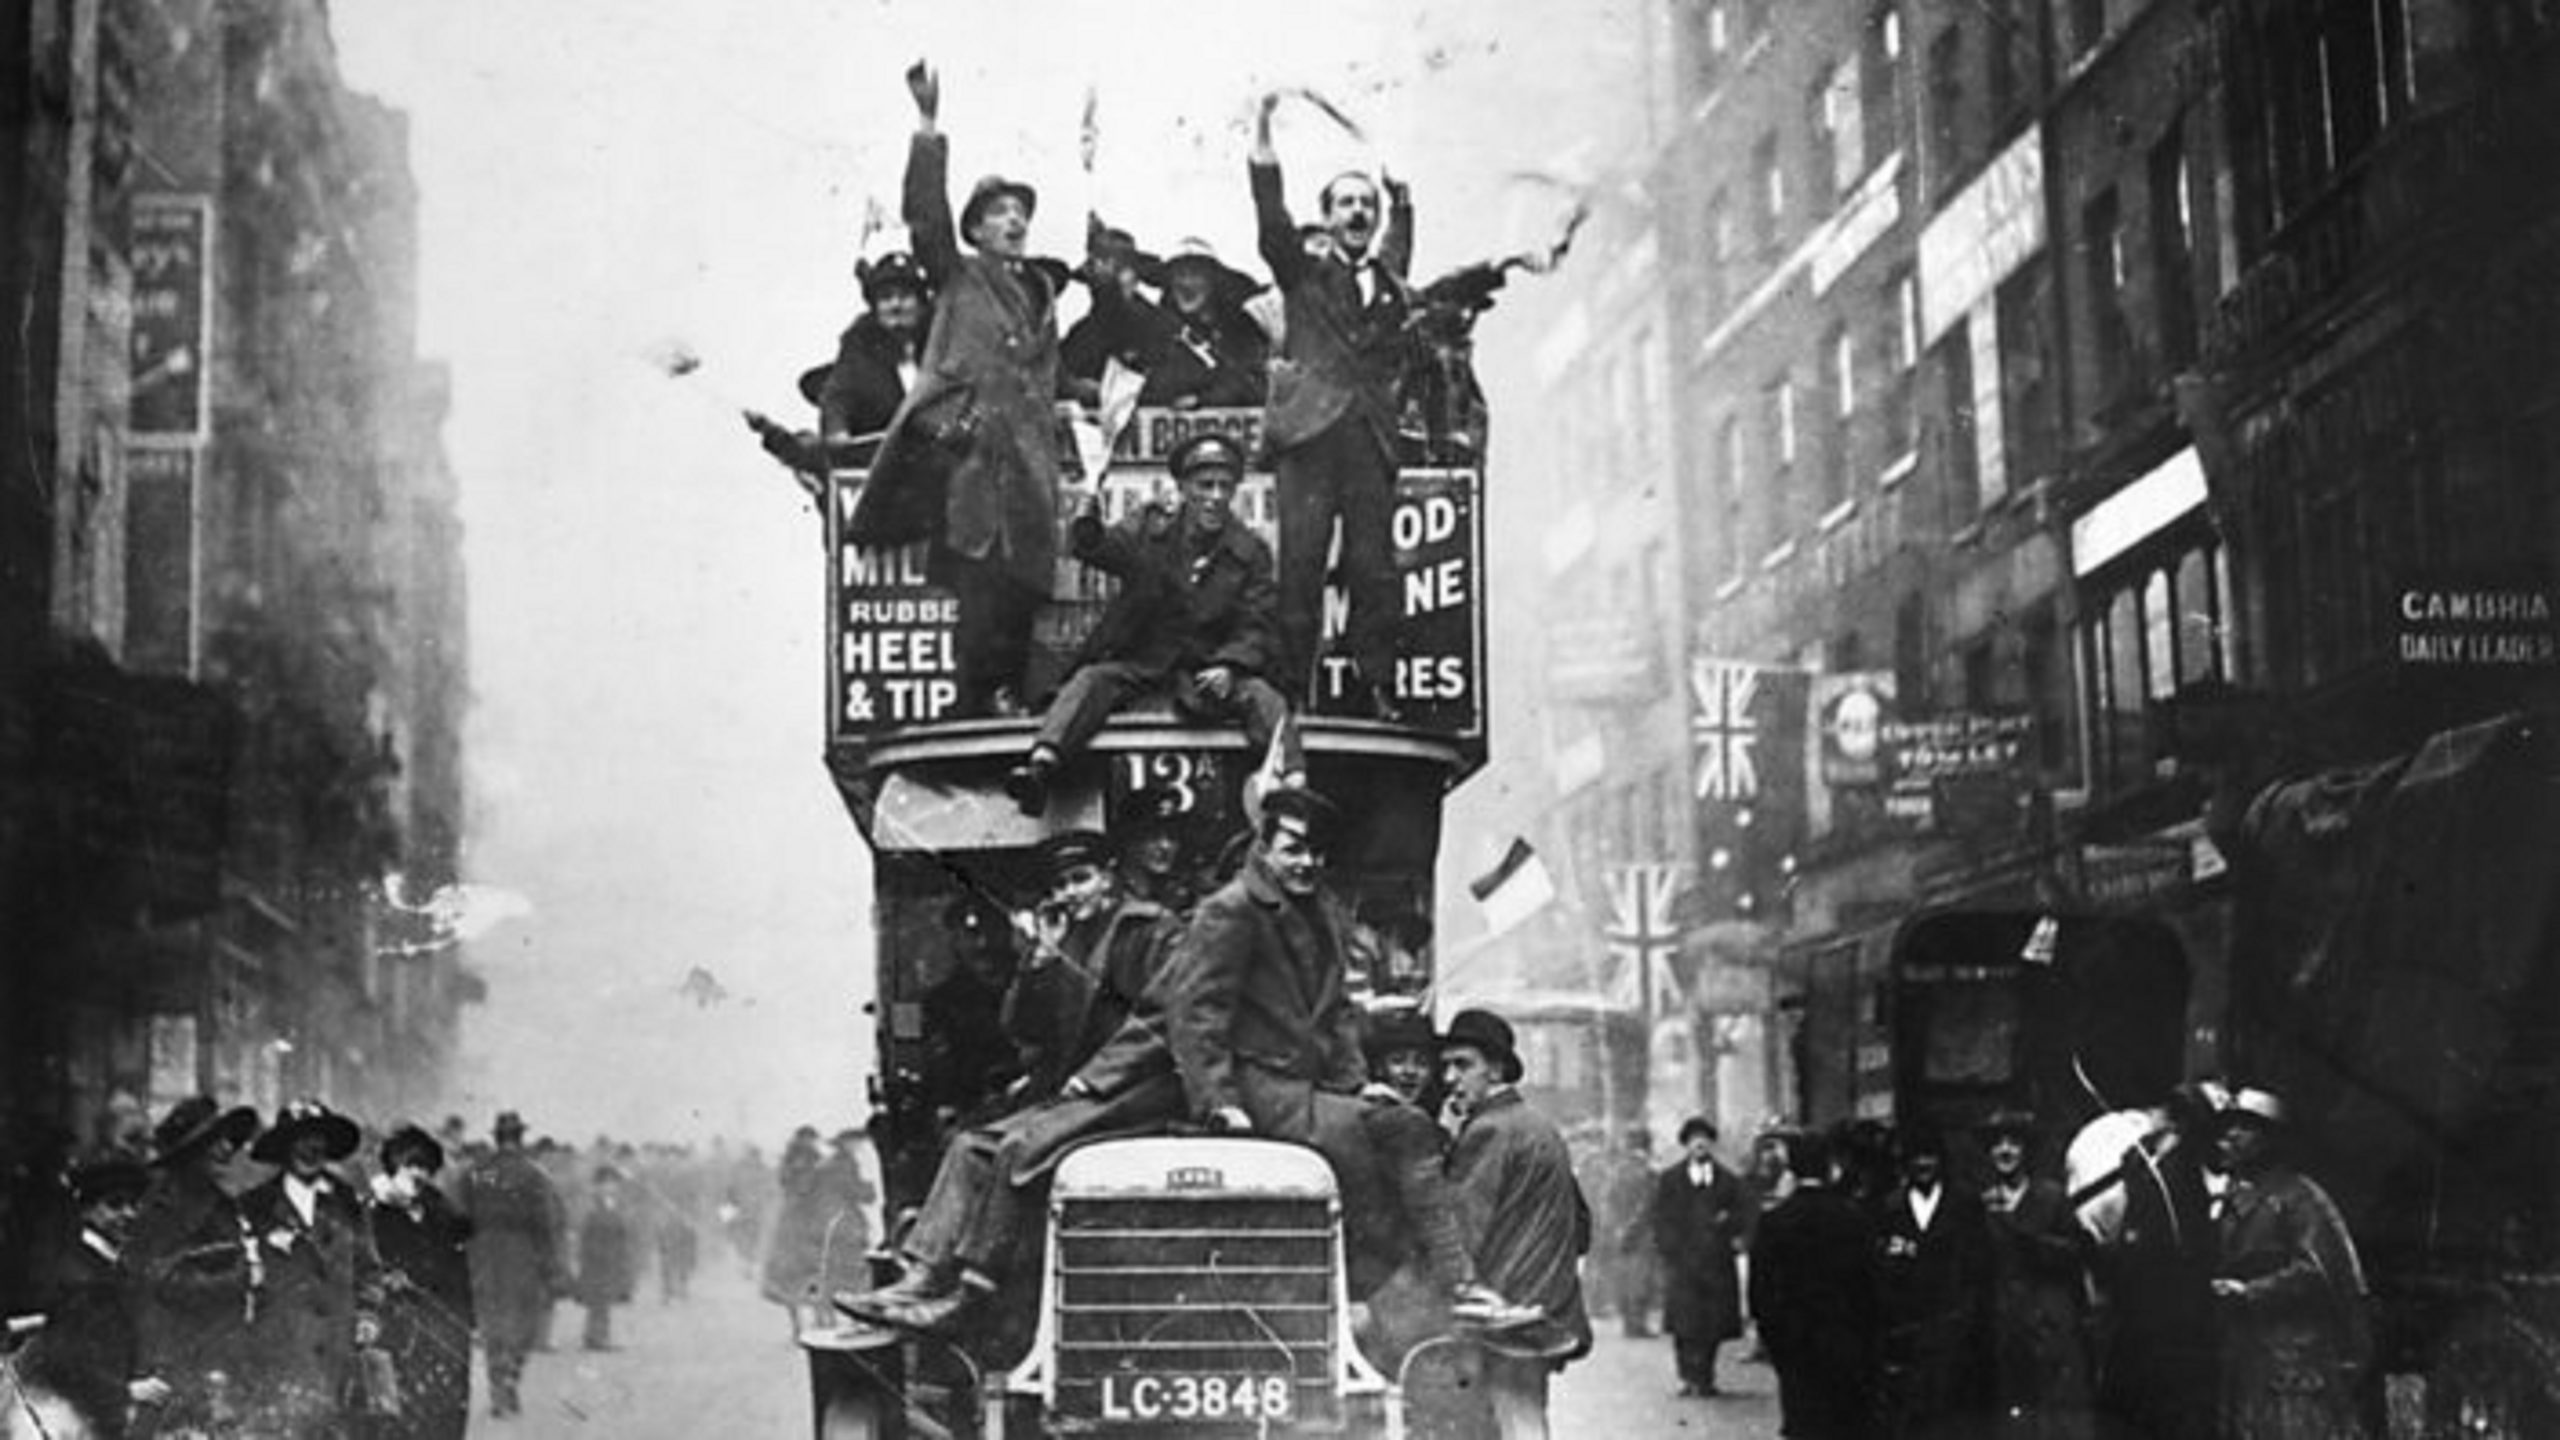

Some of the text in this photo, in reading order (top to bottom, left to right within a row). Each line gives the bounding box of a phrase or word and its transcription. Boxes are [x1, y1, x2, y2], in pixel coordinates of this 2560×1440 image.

[843, 543, 928, 586] MIL
[849, 599, 960, 624] RUBBE
[843, 630, 957, 673] HEEL
[2400, 633, 2465, 663] DAILY
[846, 679, 958, 721] & TIP
